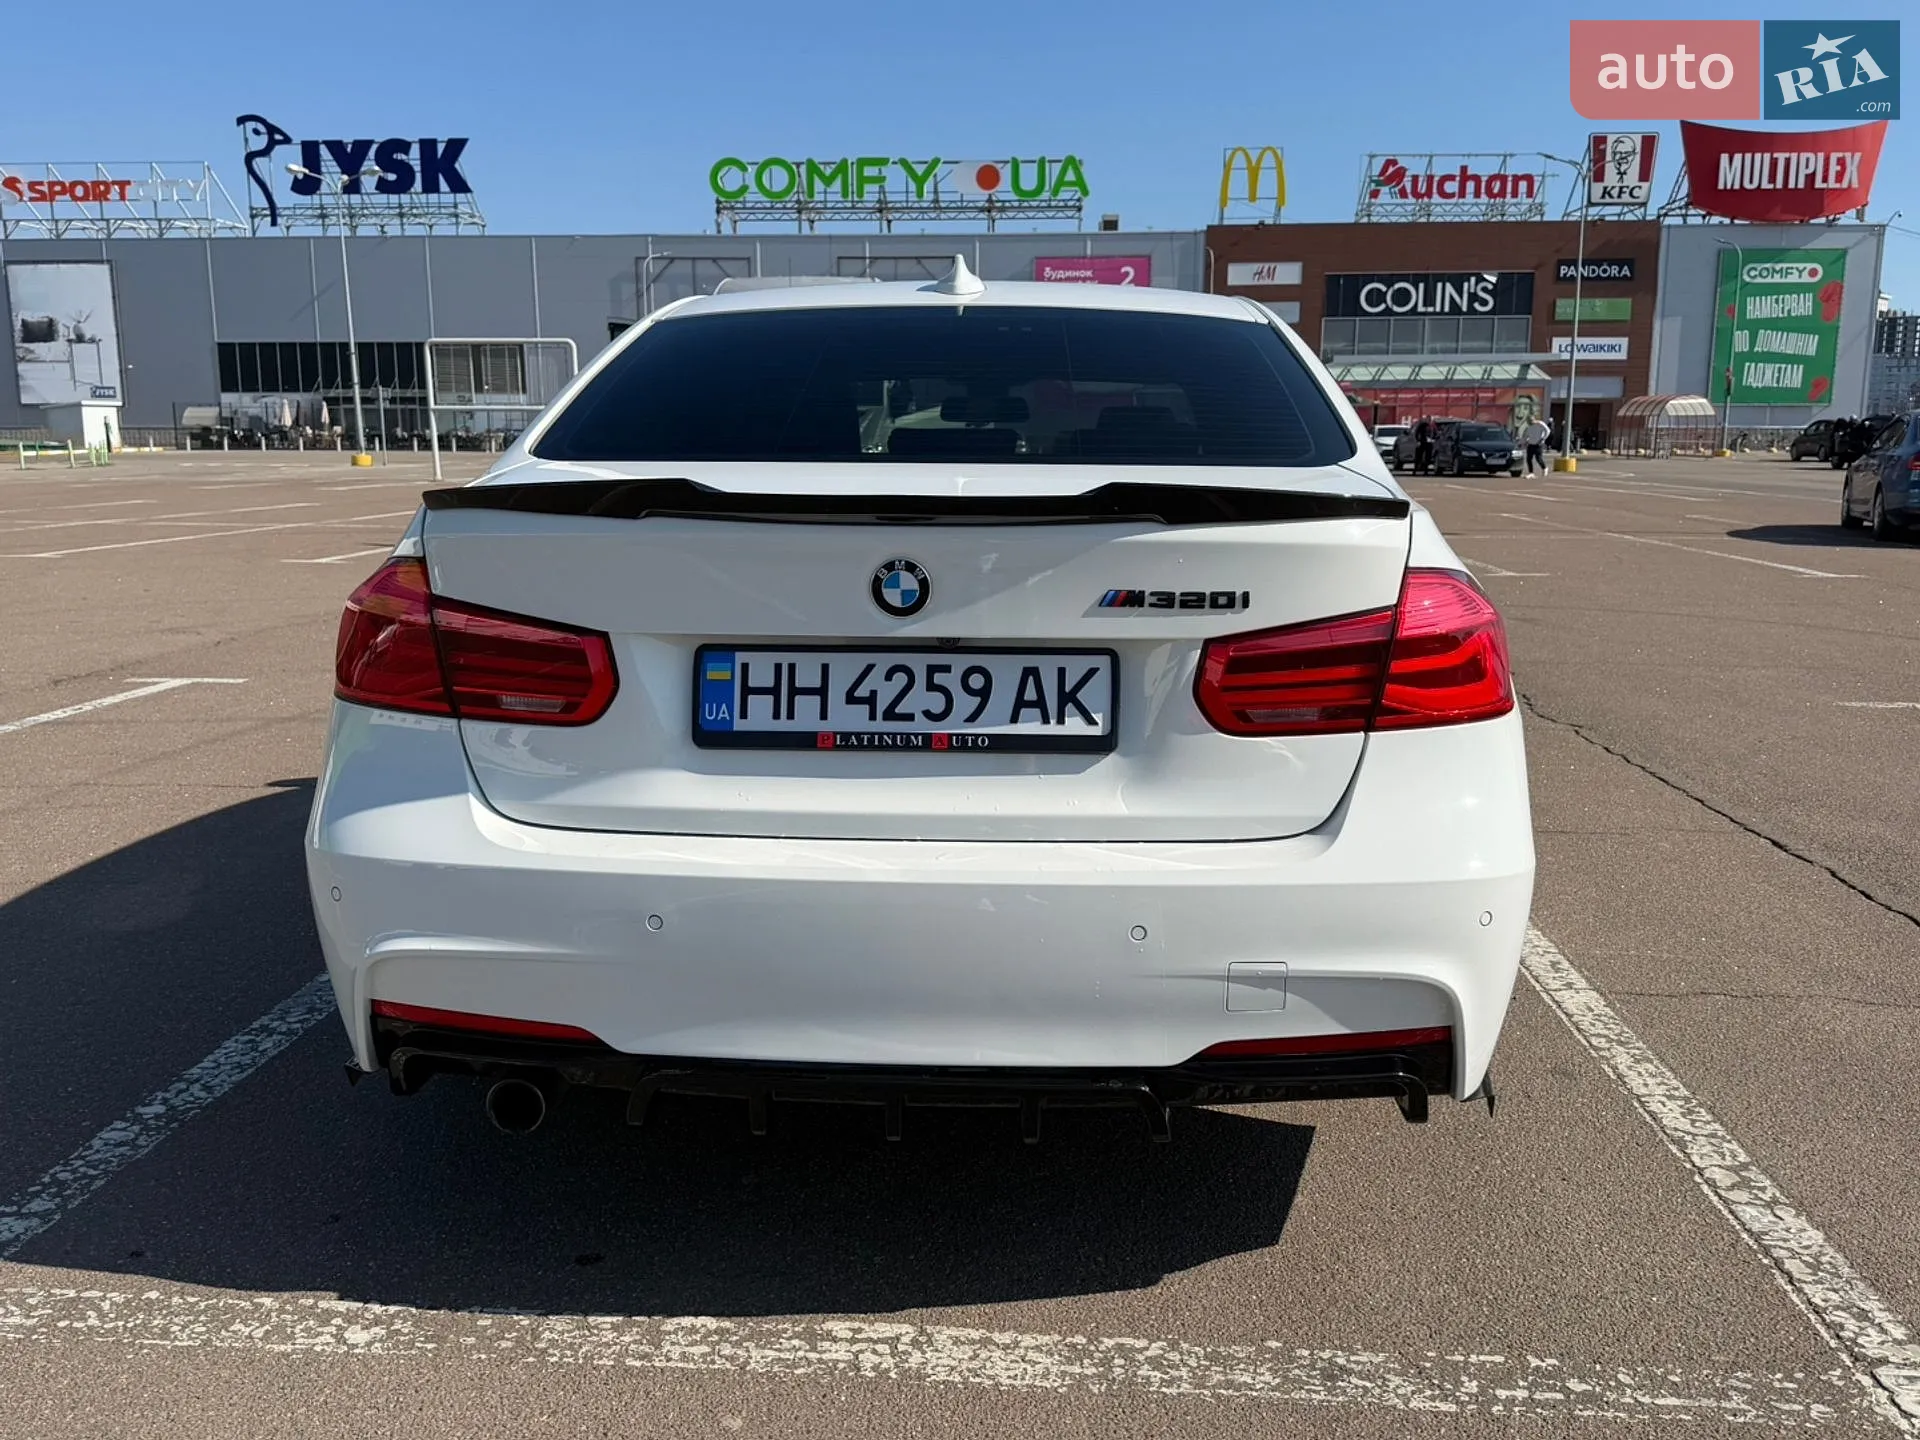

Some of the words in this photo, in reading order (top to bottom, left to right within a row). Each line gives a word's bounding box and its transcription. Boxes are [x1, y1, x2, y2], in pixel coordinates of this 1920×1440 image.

[290, 138, 473, 195] JYSK
[708, 156, 942, 201] COMFY
[1009, 154, 1090, 199] UA
[1716, 152, 1863, 190] MULTIPLEX
[27, 179, 132, 202] SPORT
[1369, 158, 1535, 200] Auchan
[1600, 184, 1643, 200] KFC
[1043, 266, 1094, 280] будинок
[1120, 266, 1135, 286] 2
[1559, 262, 1632, 278] PANDORA
[1746, 265, 1808, 281] COMFY
[1360, 276, 1495, 314] COLIN'S
[1746, 293, 1814, 319] НАМБЕРВАН
[1734, 330, 1749, 353] ПО
[1742, 362, 1804, 389] ГАДЖЕТАМ
[876, 559, 926, 580] BMW
[844, 664, 994, 724] 4259
[1009, 666, 1102, 727] AK
[705, 703, 730, 721] UA
[817, 732, 924, 748] PLATINUM
[931, 733, 990, 749] AUTO
